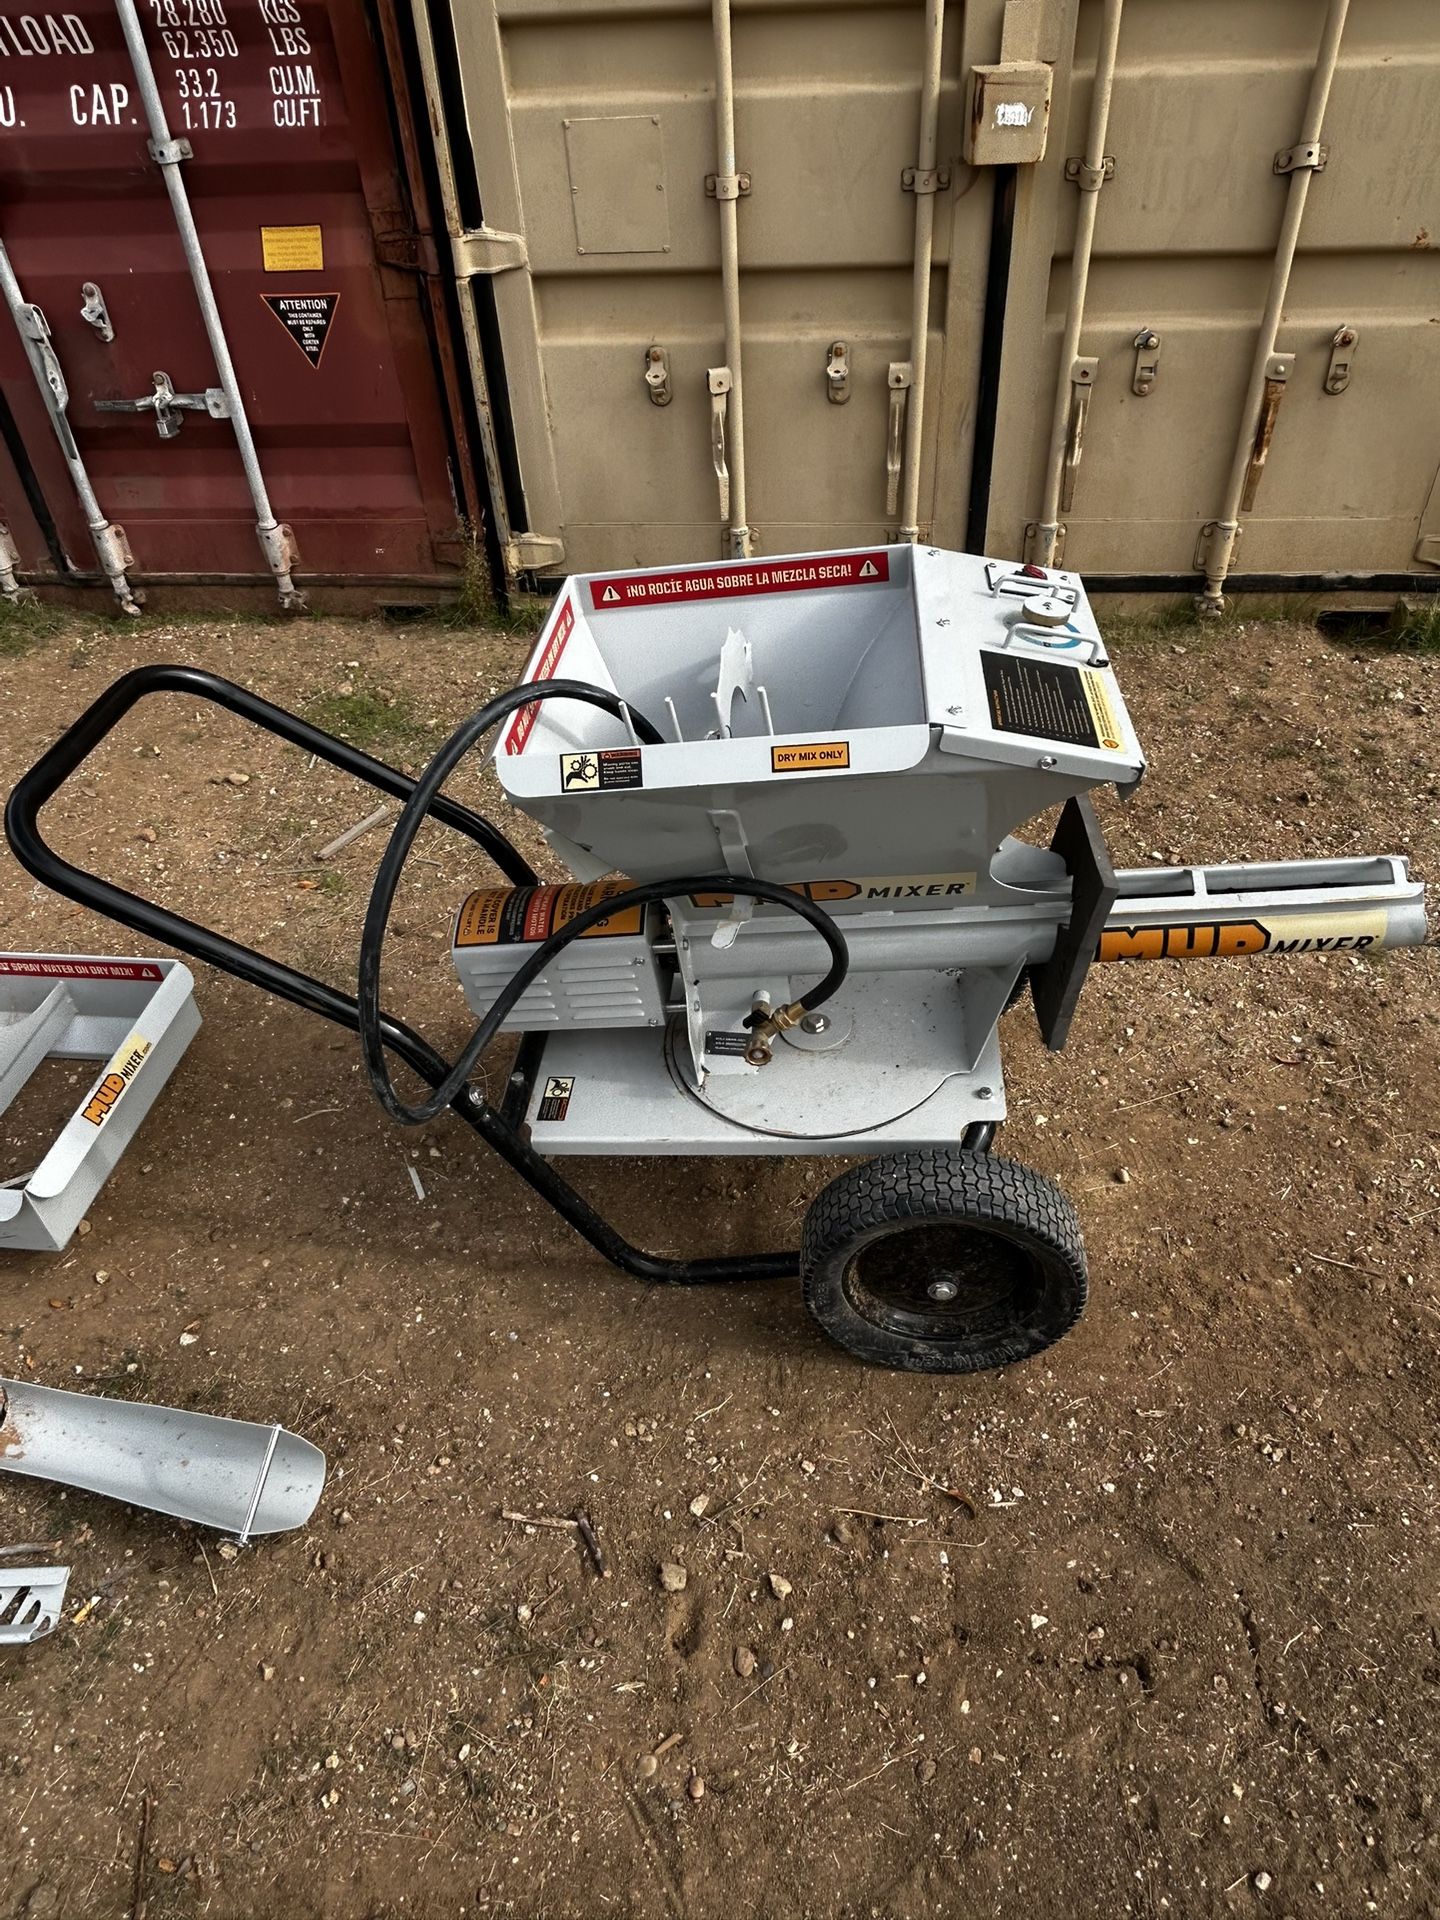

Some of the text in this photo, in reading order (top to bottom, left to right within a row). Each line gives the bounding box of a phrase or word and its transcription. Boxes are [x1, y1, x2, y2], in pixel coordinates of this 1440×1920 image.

[259, 0, 302, 24] KGS
[162, 27, 311, 58] 62.350 LBS
[175, 65, 320, 98] 33.2 CU.M.
[70, 84, 137, 125] CAP.
[273, 98, 321, 126] CU.FT
[280, 299, 328, 310] ATTENTION
[685, 577, 715, 592] AGUA
[716, 573, 754, 589] SOBRE
[755, 571, 770, 585] LA
[771, 567, 817, 583] MEZCLA
[818, 563, 852, 579] SECA!
[778, 750, 843, 762] DRY MIX ONLY
[867, 883, 965, 899] MIXER
[477, 904, 490, 935] HANDLE
[488, 900, 502, 923] COVER
[486, 925, 496, 934] IS
[1093, 919, 1271, 962] MUD
[10, 962, 40, 971] SPRAY
[40, 963, 74, 974] WATER
[74, 966, 89, 974] ON
[89, 966, 109, 976] DRY
[109, 967, 135, 976] MIX!
[81, 1073, 126, 1126] MUD
